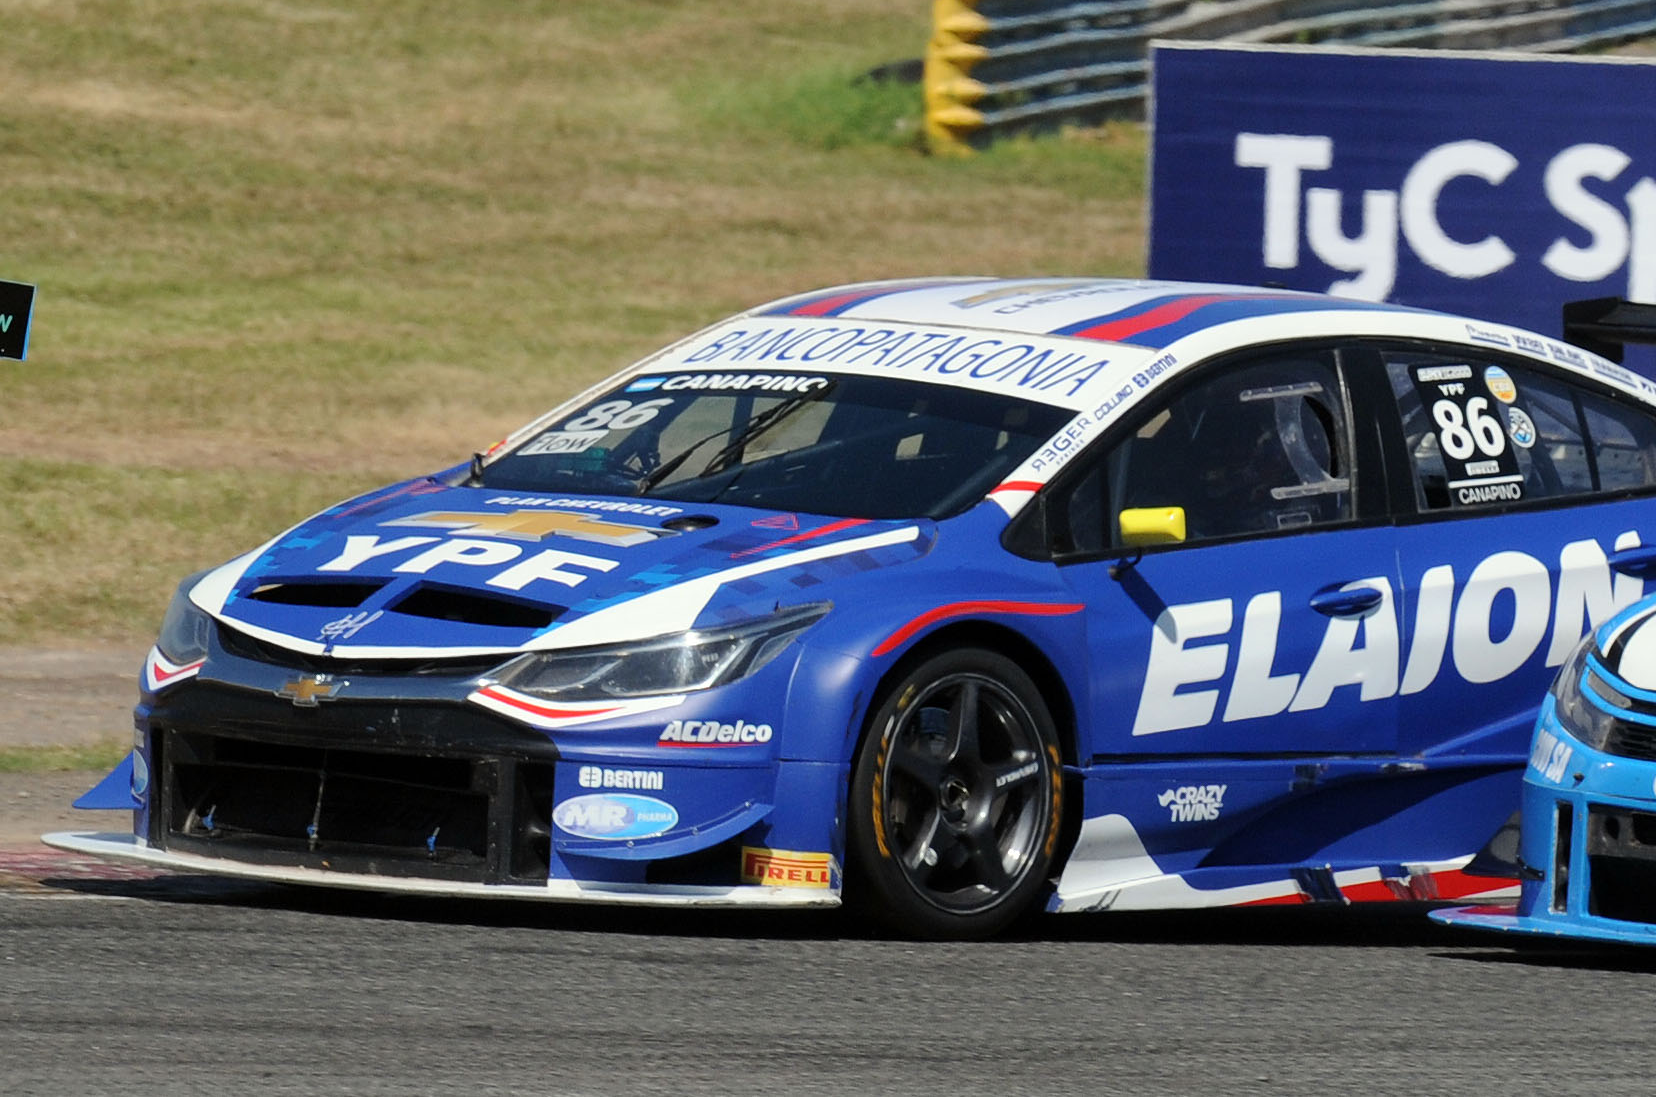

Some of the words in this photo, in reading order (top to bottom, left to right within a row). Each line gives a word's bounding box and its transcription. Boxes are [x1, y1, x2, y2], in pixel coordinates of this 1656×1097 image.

[1235, 133, 1518, 303] TyC
[1145, 353, 1178, 380] BERTINI
[1094, 384, 1134, 421] COLLINO
[1438, 383, 1465, 396] YPF
[564, 397, 674, 430] 86
[1432, 397, 1505, 460] 86
[1458, 483, 1521, 504] CANAPINO
[317, 535, 620, 590] YPF
[1132, 531, 1645, 736] ELAION
[660, 720, 772, 743] ACDelco
[603, 769, 663, 790] BERTINI
[1176, 784, 1227, 804] CRAZY
[563, 804, 626, 827] MR
[1170, 803, 1223, 822] TWINS
[744, 853, 829, 883] PIRELL
